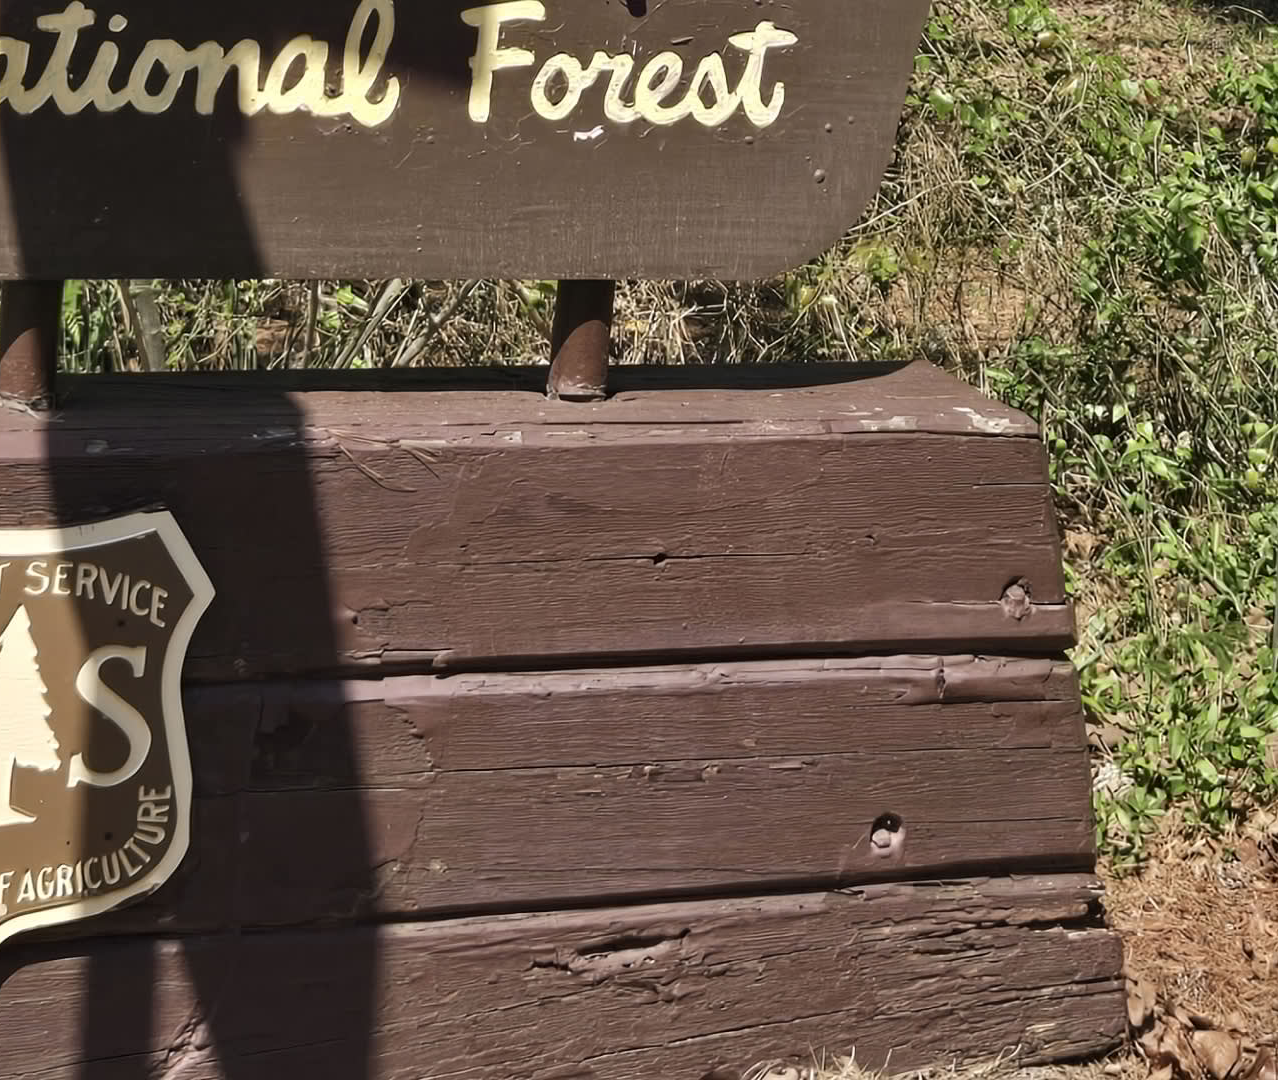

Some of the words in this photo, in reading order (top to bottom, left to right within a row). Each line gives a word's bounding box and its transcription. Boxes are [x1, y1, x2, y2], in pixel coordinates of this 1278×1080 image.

[461, 0, 799, 130] Forest
[24, 561, 169, 627] SERVICE
[66, 645, 152, 788] S
[16, 785, 172, 902] AGRICULTURE
